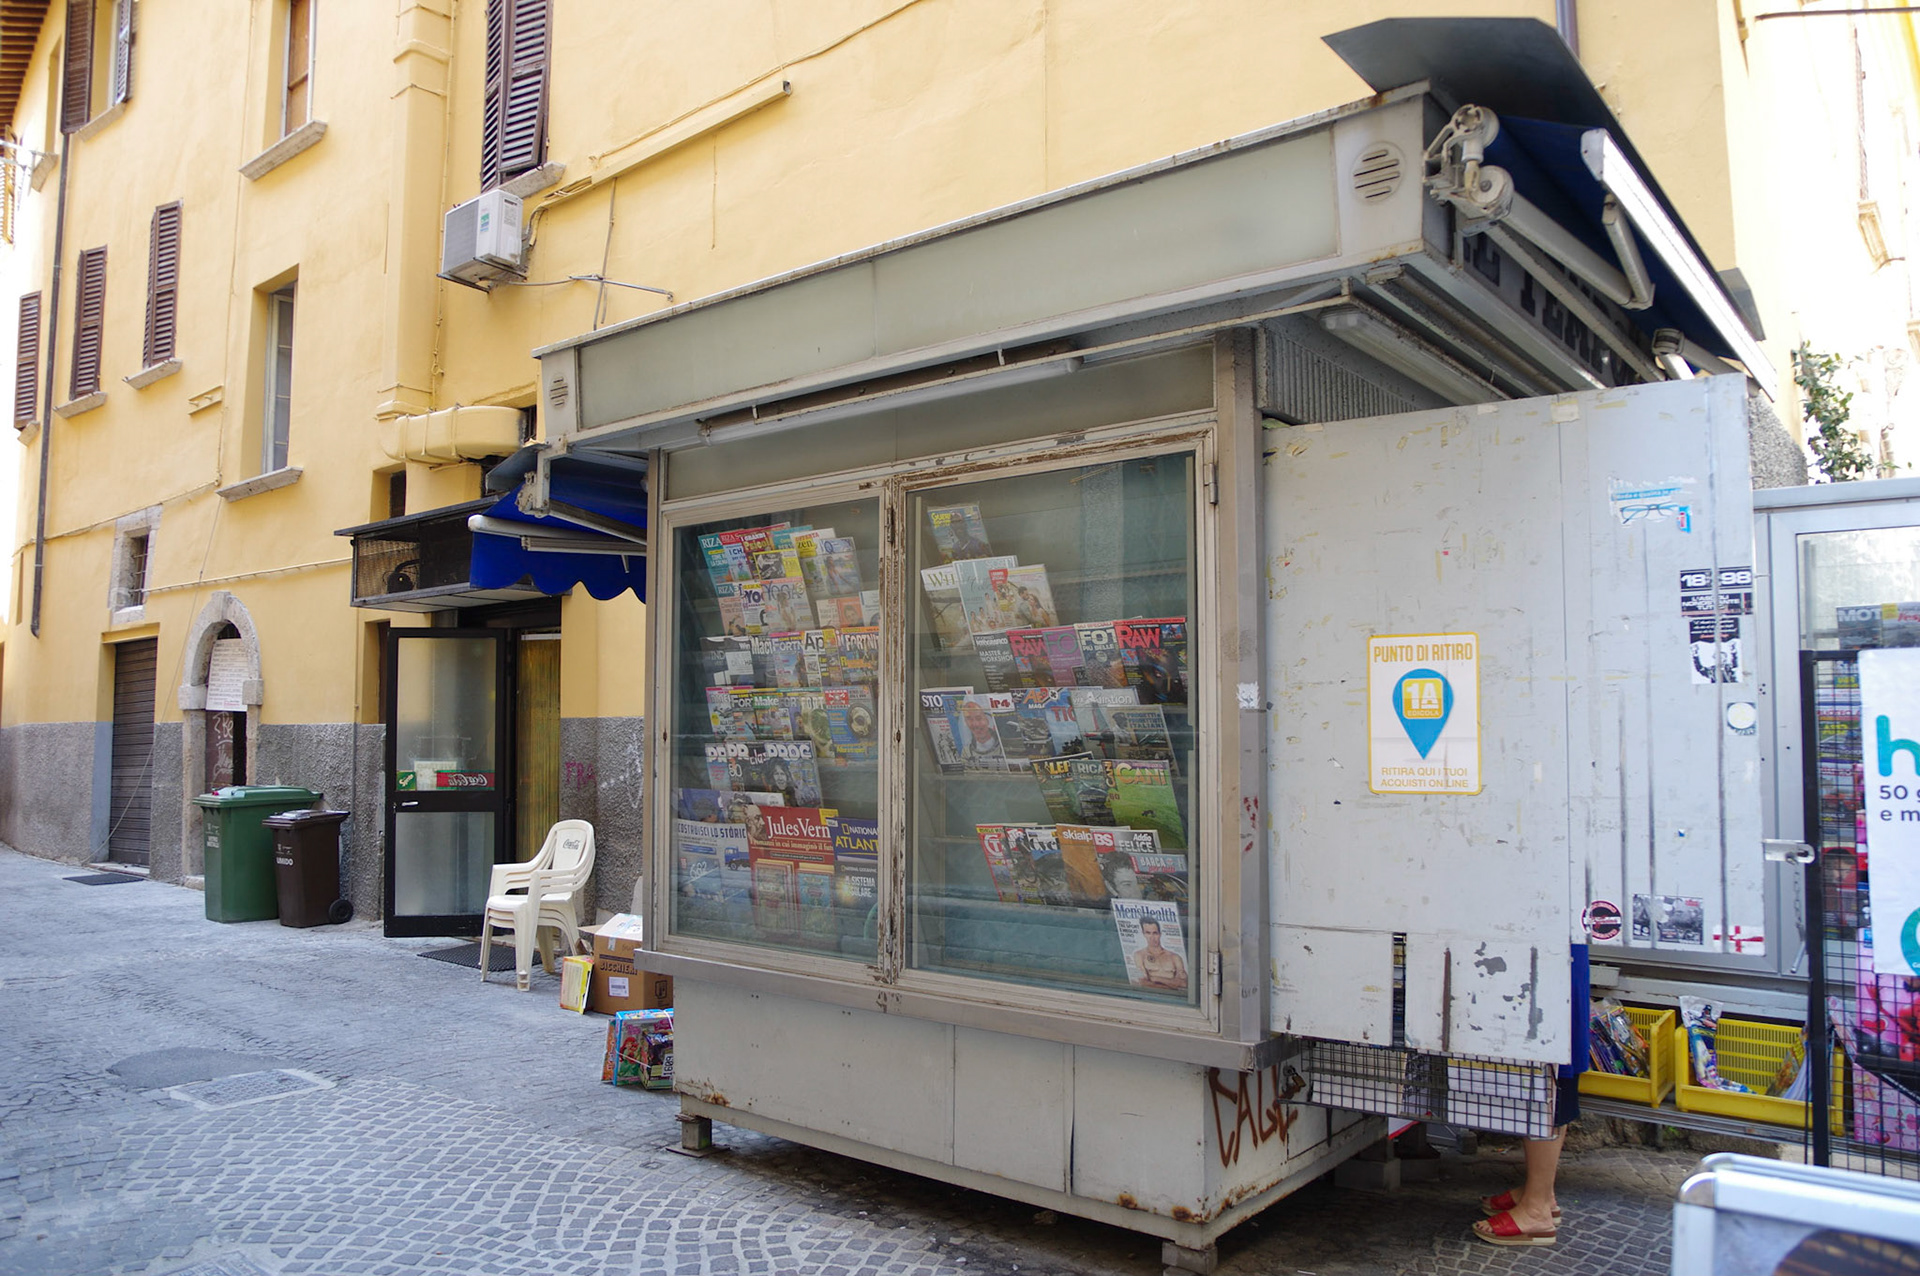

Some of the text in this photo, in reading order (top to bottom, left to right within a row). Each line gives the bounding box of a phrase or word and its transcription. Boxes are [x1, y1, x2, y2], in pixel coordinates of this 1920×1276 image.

[701, 536, 722, 549] RIZA
[1680, 571, 1752, 587] 18 98
[1114, 624, 1161, 649] RAW
[1373, 642, 1473, 663] PUNTO DI RITIRO
[754, 695, 780, 707] Make
[1406, 682, 1440, 710] 1A
[1381, 767, 1415, 776] RITIRA
[1417, 767, 1436, 776] QUI
[1444, 767, 1468, 777] TUOI
[1380, 778, 1469, 788] ACQUISTI ON LINE
[1880, 784, 1908, 800] 50
[1880, 810, 1892, 821] e
[766, 815, 832, 839] Jules Vern
[1062, 828, 1093, 846] skialp
[1093, 833, 1113, 847] BS
[1133, 833, 1152, 842] Addio
[1118, 840, 1155, 853] FELICE
[851, 875, 876, 887] SISTEMA
